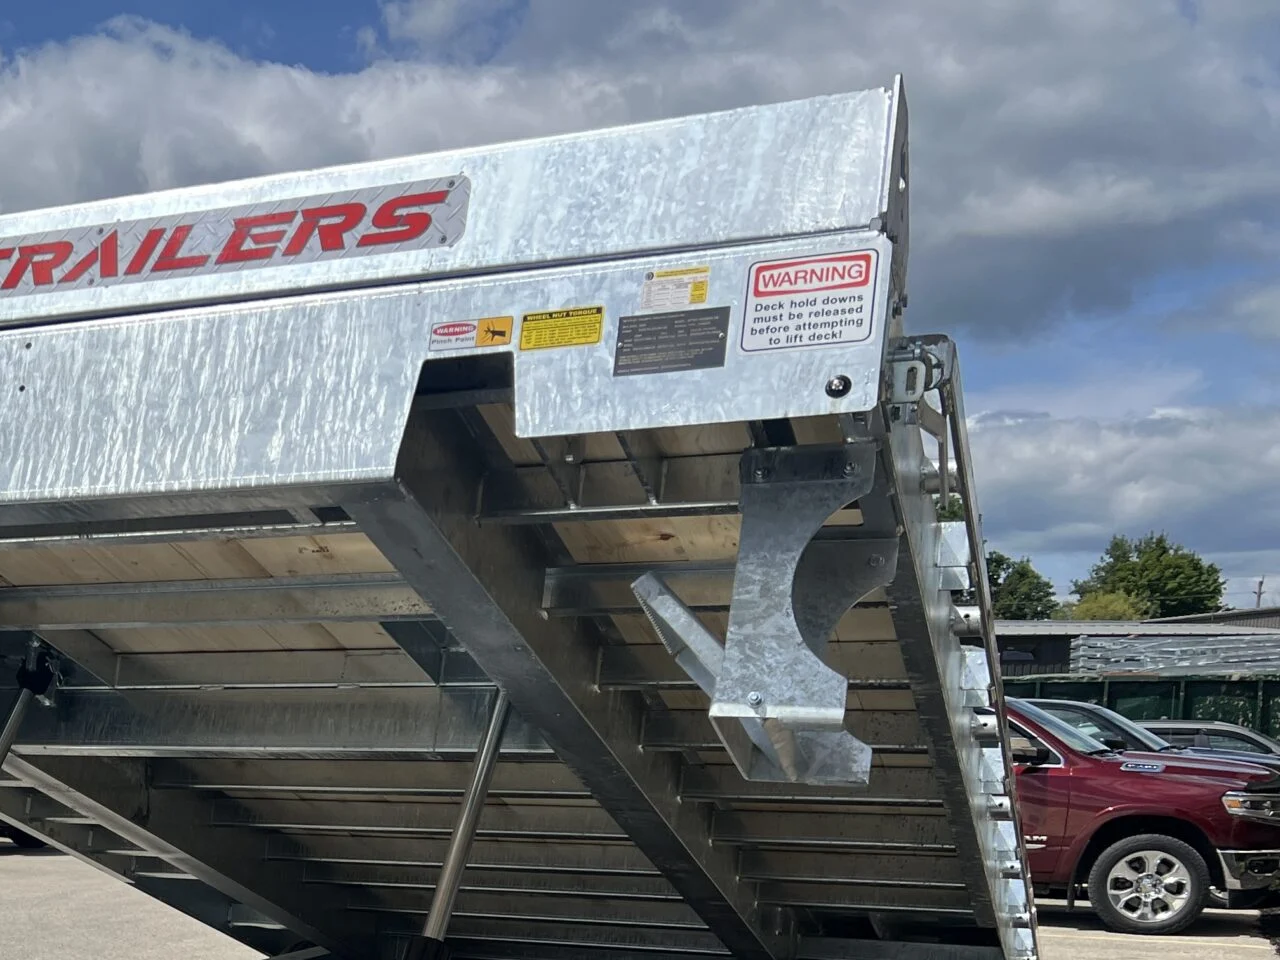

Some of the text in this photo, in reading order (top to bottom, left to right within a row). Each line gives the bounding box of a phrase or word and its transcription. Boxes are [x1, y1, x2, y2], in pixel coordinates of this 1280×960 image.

[761, 263, 863, 289] WARNING
[754, 294, 864, 313] Deck hold downs
[753, 305, 863, 324] must be released
[436, 324, 475, 335] WARNING
[750, 317, 864, 336] before attempting
[769, 330, 842, 346] to lift deck!
